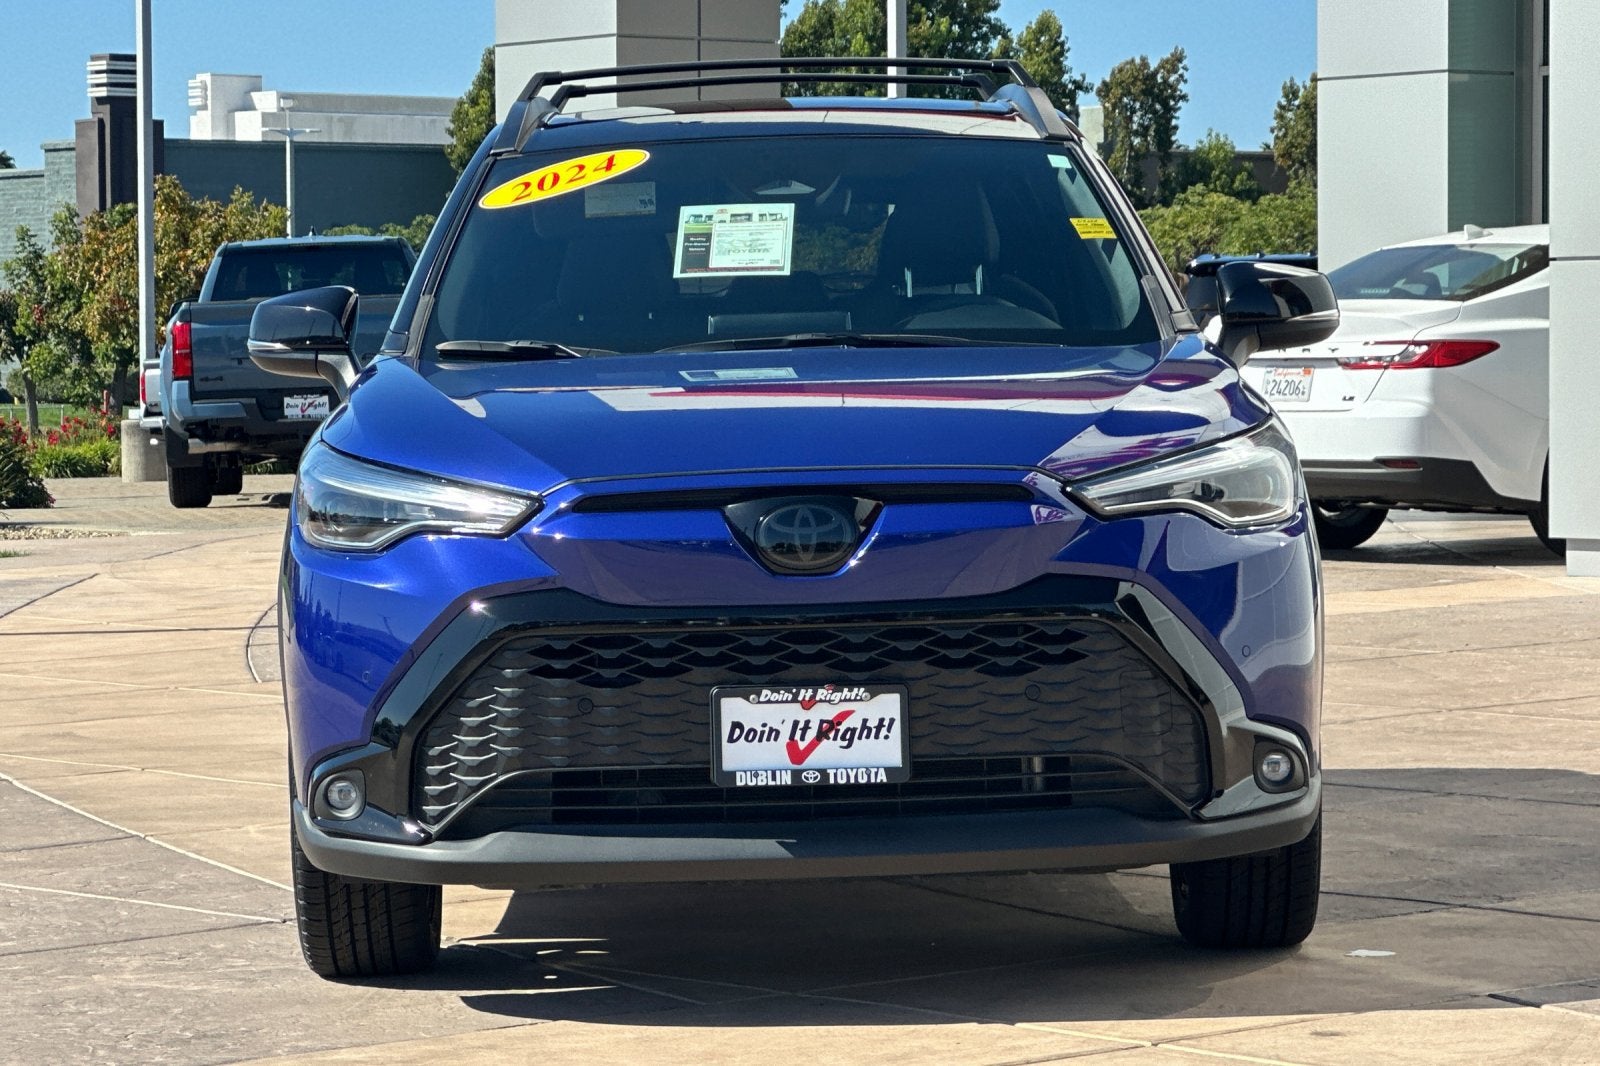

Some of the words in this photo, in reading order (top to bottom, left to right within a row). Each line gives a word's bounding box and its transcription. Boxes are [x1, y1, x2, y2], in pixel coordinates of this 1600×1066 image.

[511, 154, 616, 203] 2024
[1269, 379, 1303, 396] 24206
[759, 688, 796, 702] Doin'
[797, 688, 814, 701] It
[815, 687, 866, 705] Right!
[726, 719, 786, 744] Doin'
[788, 719, 812, 742] It
[816, 717, 896, 749] Right!
[735, 769, 792, 786] DUBLIN
[826, 767, 888, 784] TOYOTA
